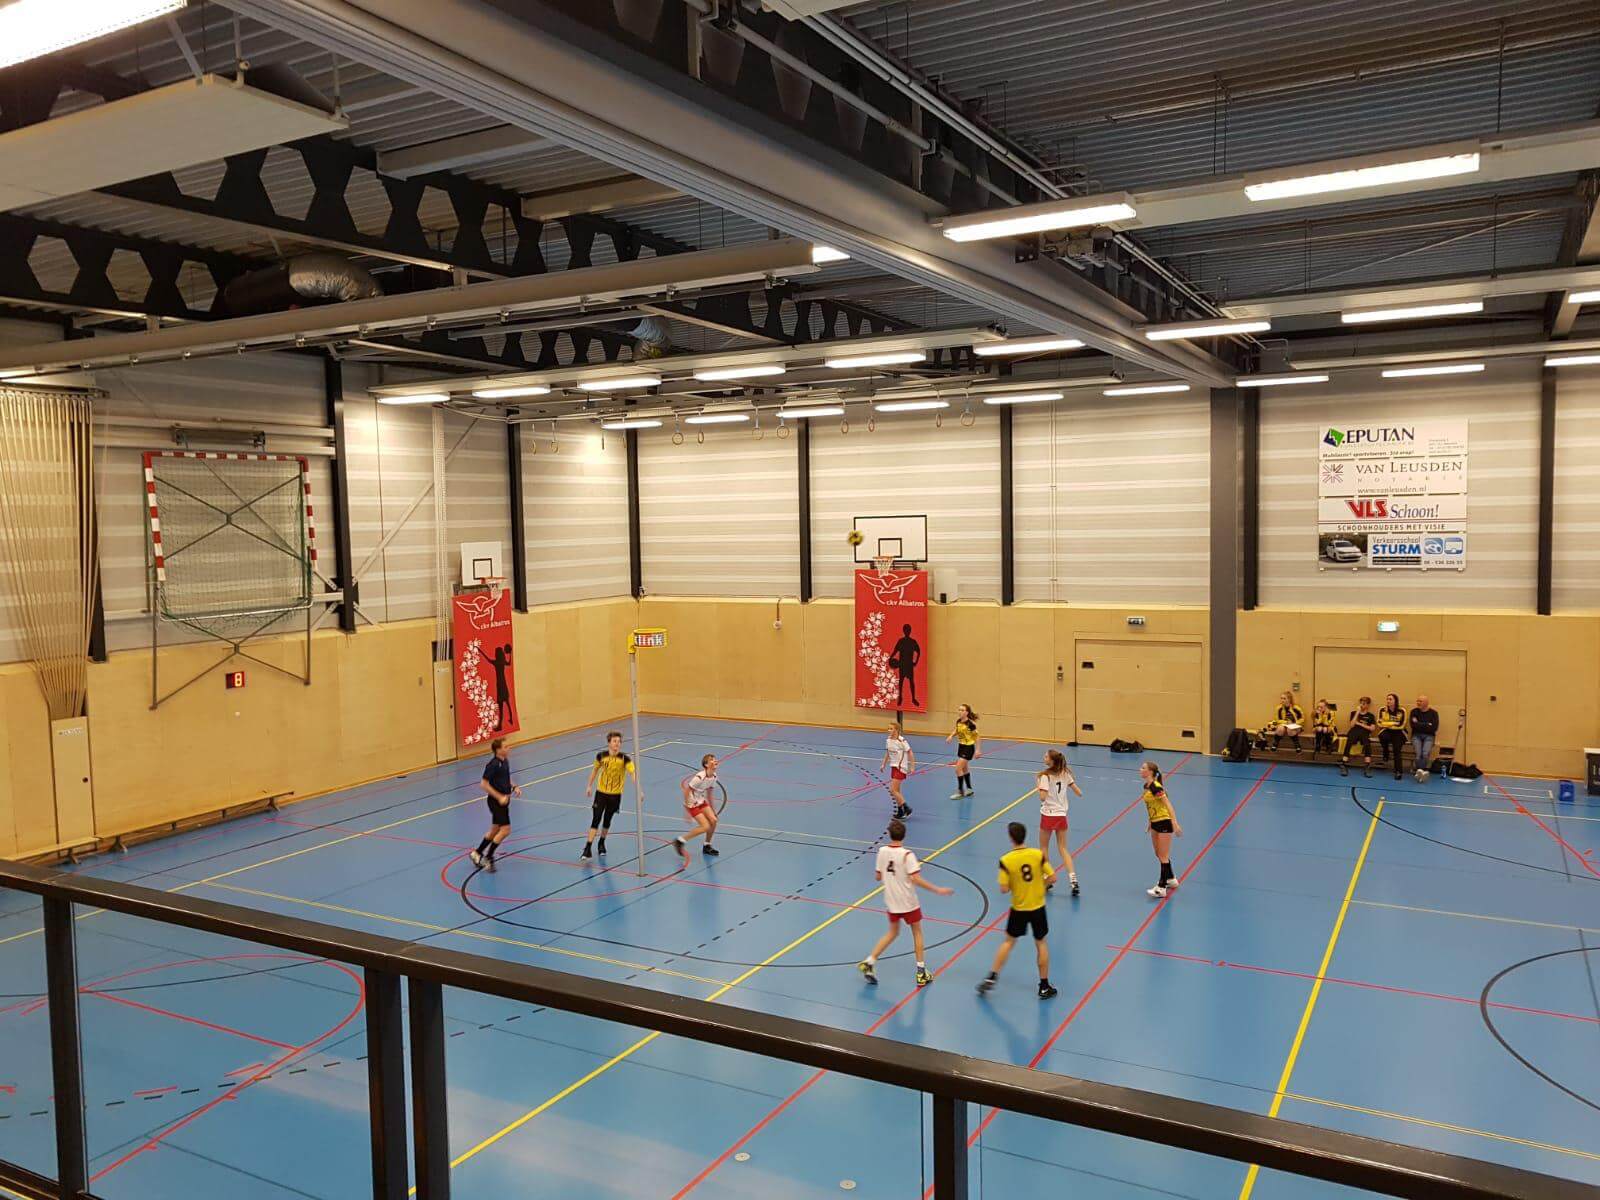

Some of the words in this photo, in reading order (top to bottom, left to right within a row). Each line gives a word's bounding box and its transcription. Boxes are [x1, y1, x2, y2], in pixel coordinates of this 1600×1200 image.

[1356, 464, 1385, 474] VAN
[1345, 499, 1388, 519] VLS
[1389, 503, 1440, 519] Schoon!
[1372, 544, 1421, 554] STURM
[234, 672, 243, 687] 8
[886, 860, 896, 876] 4
[1020, 863, 1033, 882] 8
